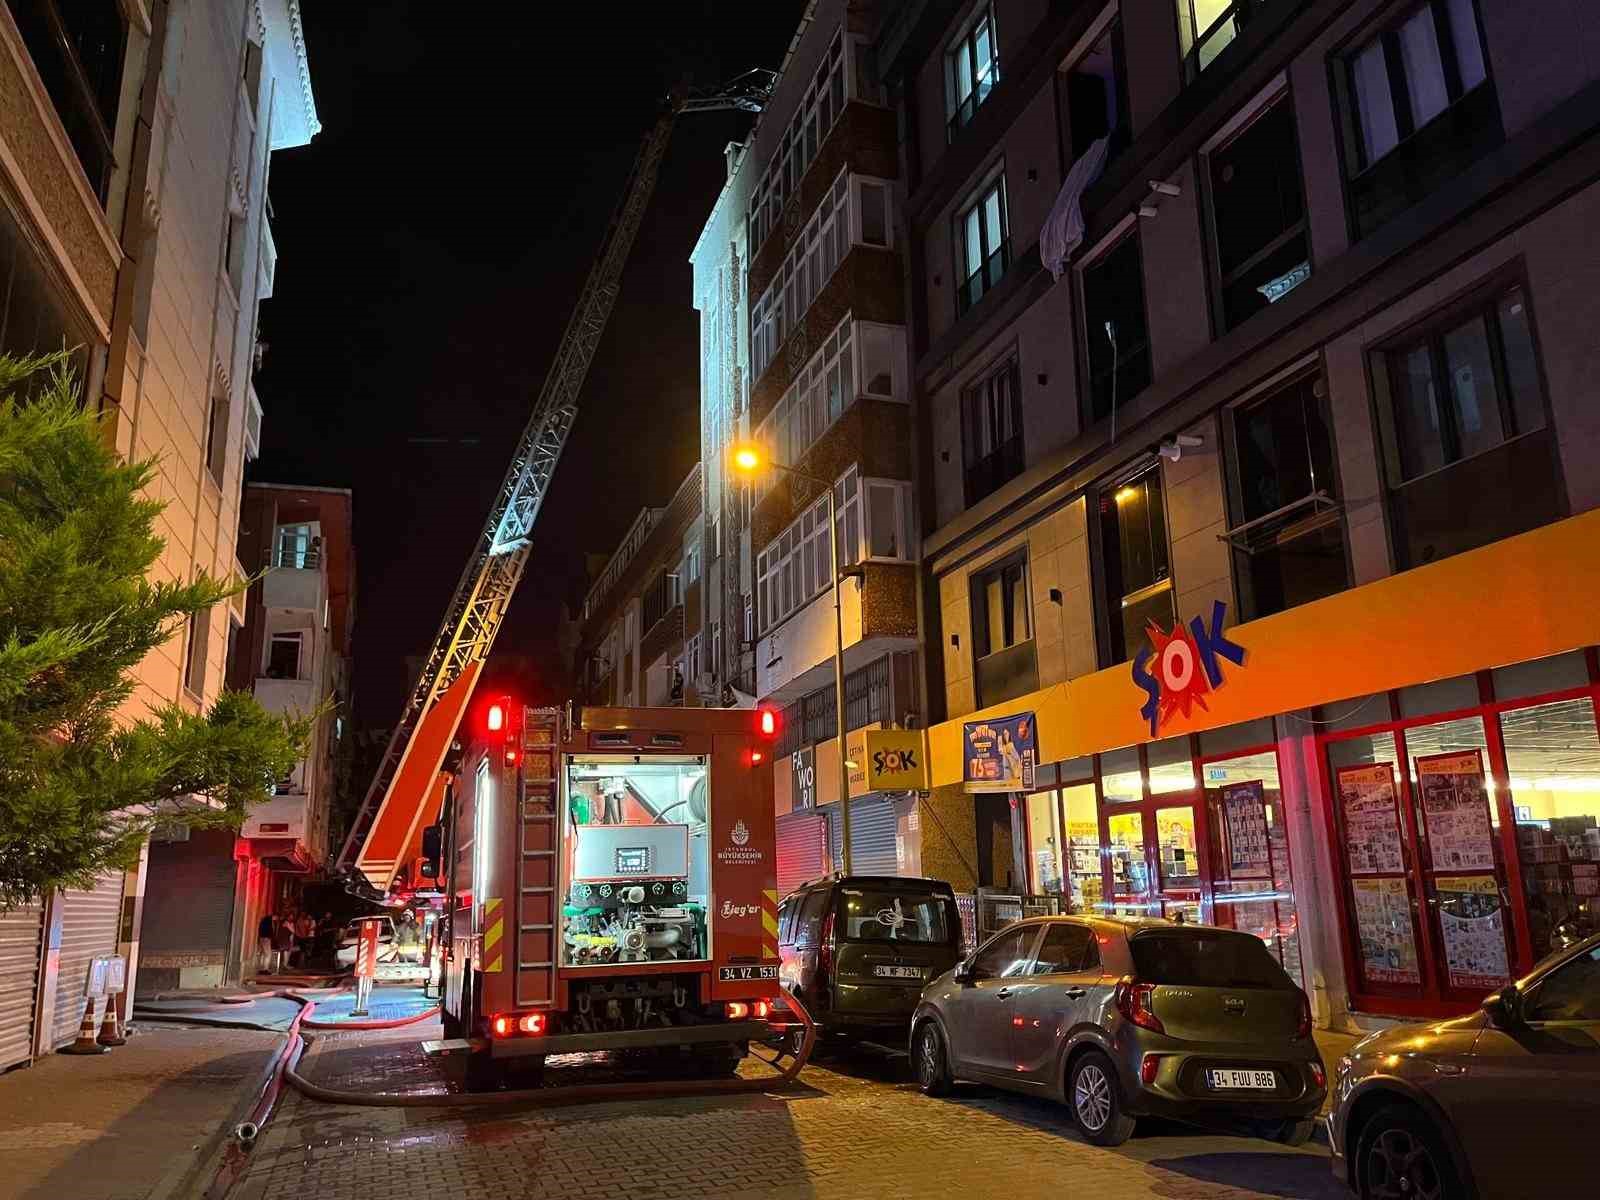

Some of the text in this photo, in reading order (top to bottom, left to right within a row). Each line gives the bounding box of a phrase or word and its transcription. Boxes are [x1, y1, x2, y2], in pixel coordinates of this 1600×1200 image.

[792, 750, 803, 772] FA
[797, 766, 814, 790] WO
[724, 966, 777, 980] 34 VZ 1531
[877, 966, 886, 976] 34
[1214, 1071, 1274, 1087] 34 FUU 886
